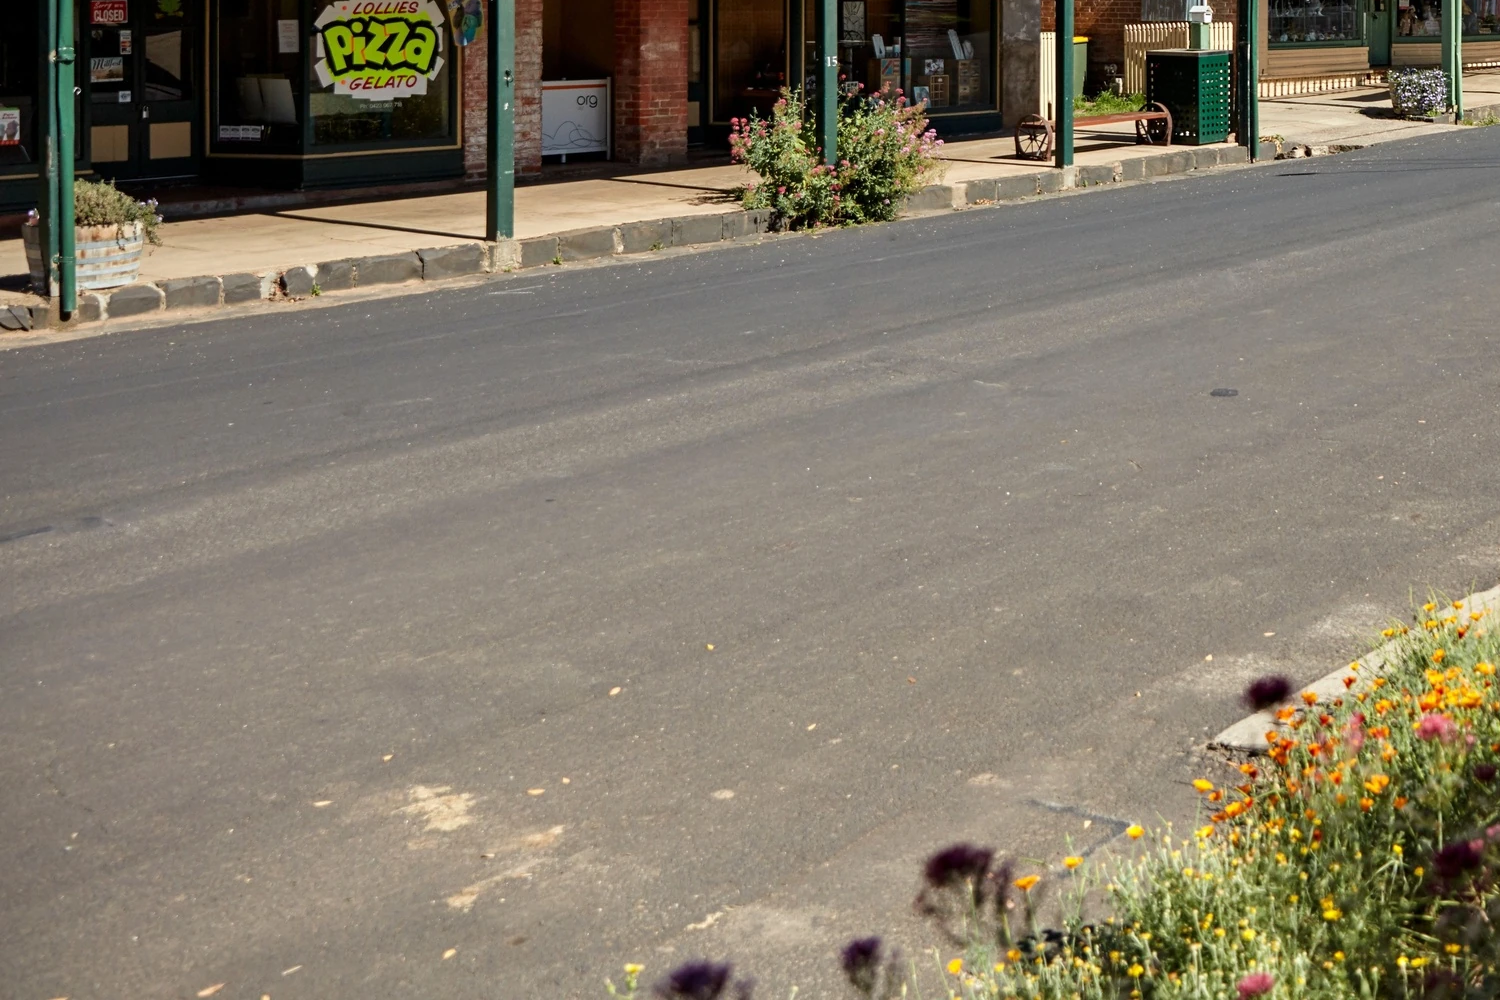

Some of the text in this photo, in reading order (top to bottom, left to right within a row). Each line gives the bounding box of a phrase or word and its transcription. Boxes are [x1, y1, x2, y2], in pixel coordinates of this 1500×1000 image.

[352, 1, 419, 15] LOLLIES
[93, 10, 124, 21] CLOSED
[826, 55, 838, 67] 15
[350, 75, 417, 90] GELATO
[577, 95, 598, 108] org
